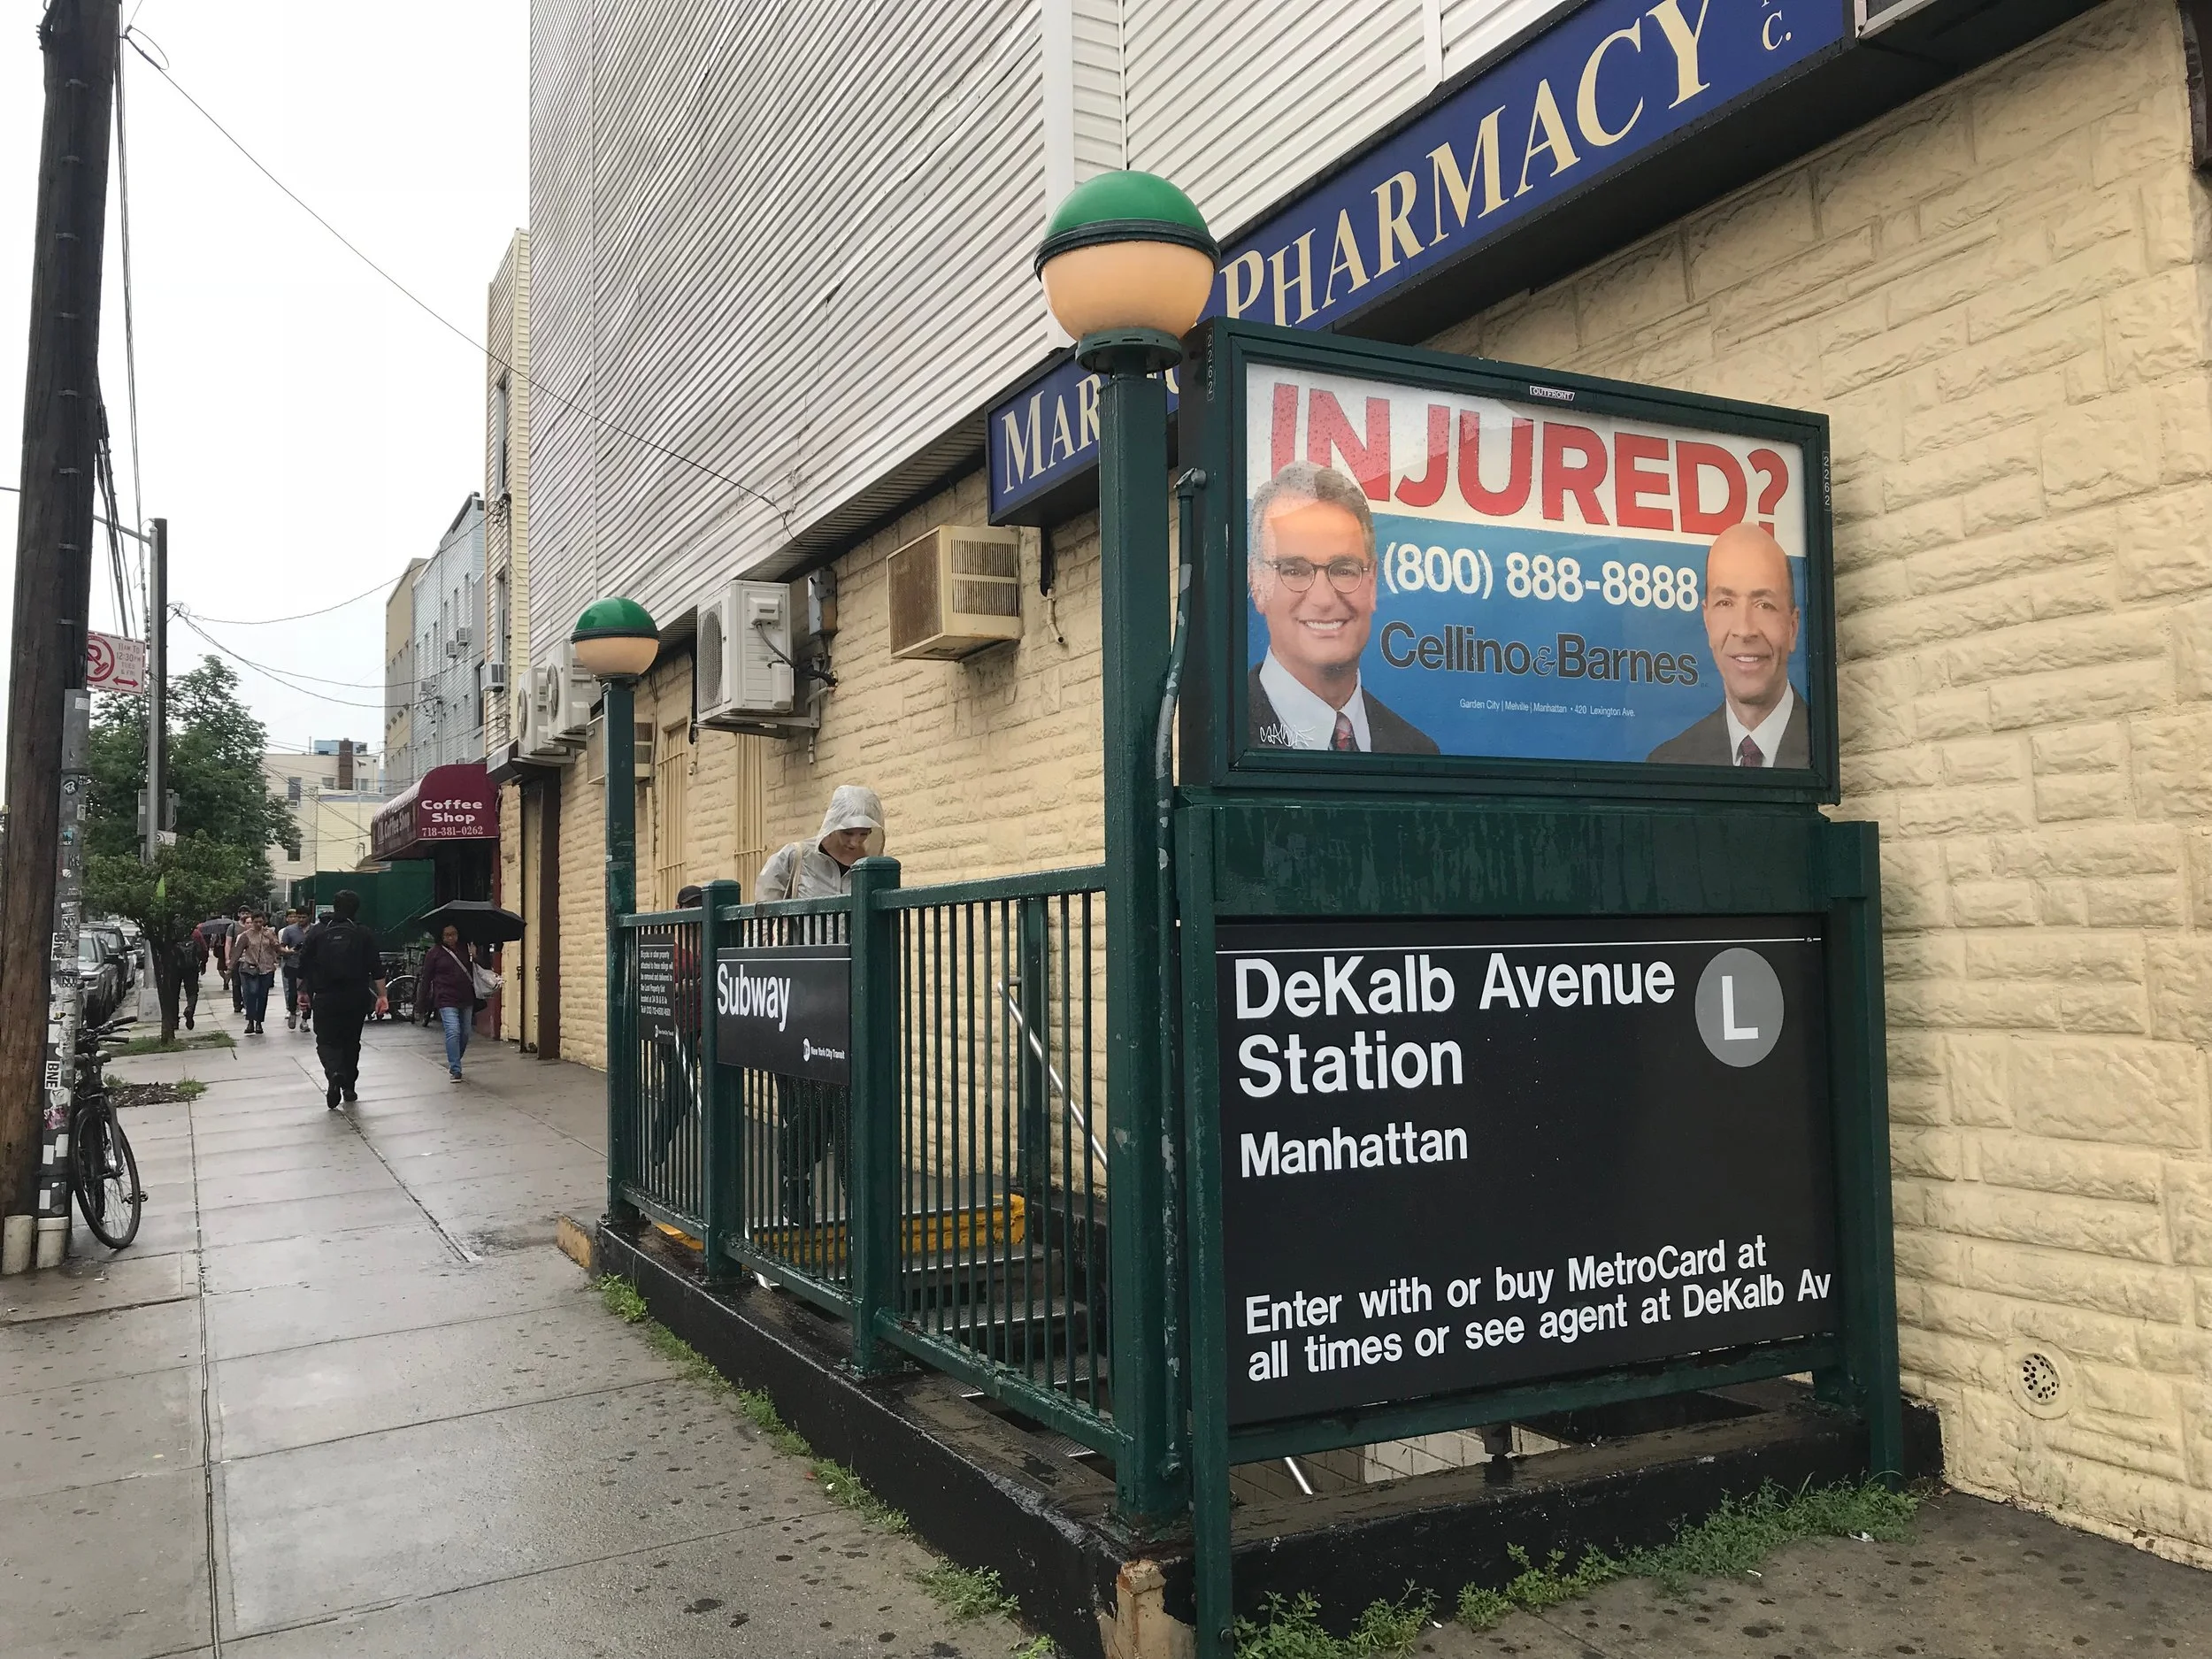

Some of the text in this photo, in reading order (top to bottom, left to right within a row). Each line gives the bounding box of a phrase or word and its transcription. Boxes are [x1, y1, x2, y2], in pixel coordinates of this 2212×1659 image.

[1219, 0, 1710, 328] PHARMACY
[1532, 388, 1571, 400] OUTFRONT
[1271, 382, 1788, 539] INJURED?
[1384, 541, 1699, 612] (800) 888-8888
[1460, 698, 1485, 709] Garden
[1486, 700, 1500, 711] City
[1533, 703, 1567, 713] Manhattan
[1574, 704, 1586, 714] 420
[1590, 705, 1621, 718] Lexington
[1622, 708, 1635, 717] Ave.
[421, 799, 482, 810] Coffee
[421, 826, 483, 837] 718-381-0262
[431, 812, 475, 825] Shop
[718, 963, 791, 1033] Subway
[1235, 952, 1675, 1019] DeKalb Avenue
[1722, 976, 1759, 1041] L
[46, 1063, 59, 1088] BNE
[1239, 1030, 1463, 1098] Station
[1240, 1121, 1468, 1178] Manhattan
[1246, 1234, 1767, 1335] Enter with or buy MetroCard at
[1248, 1269, 1832, 1382] all times or see agent at DeKalb Av
